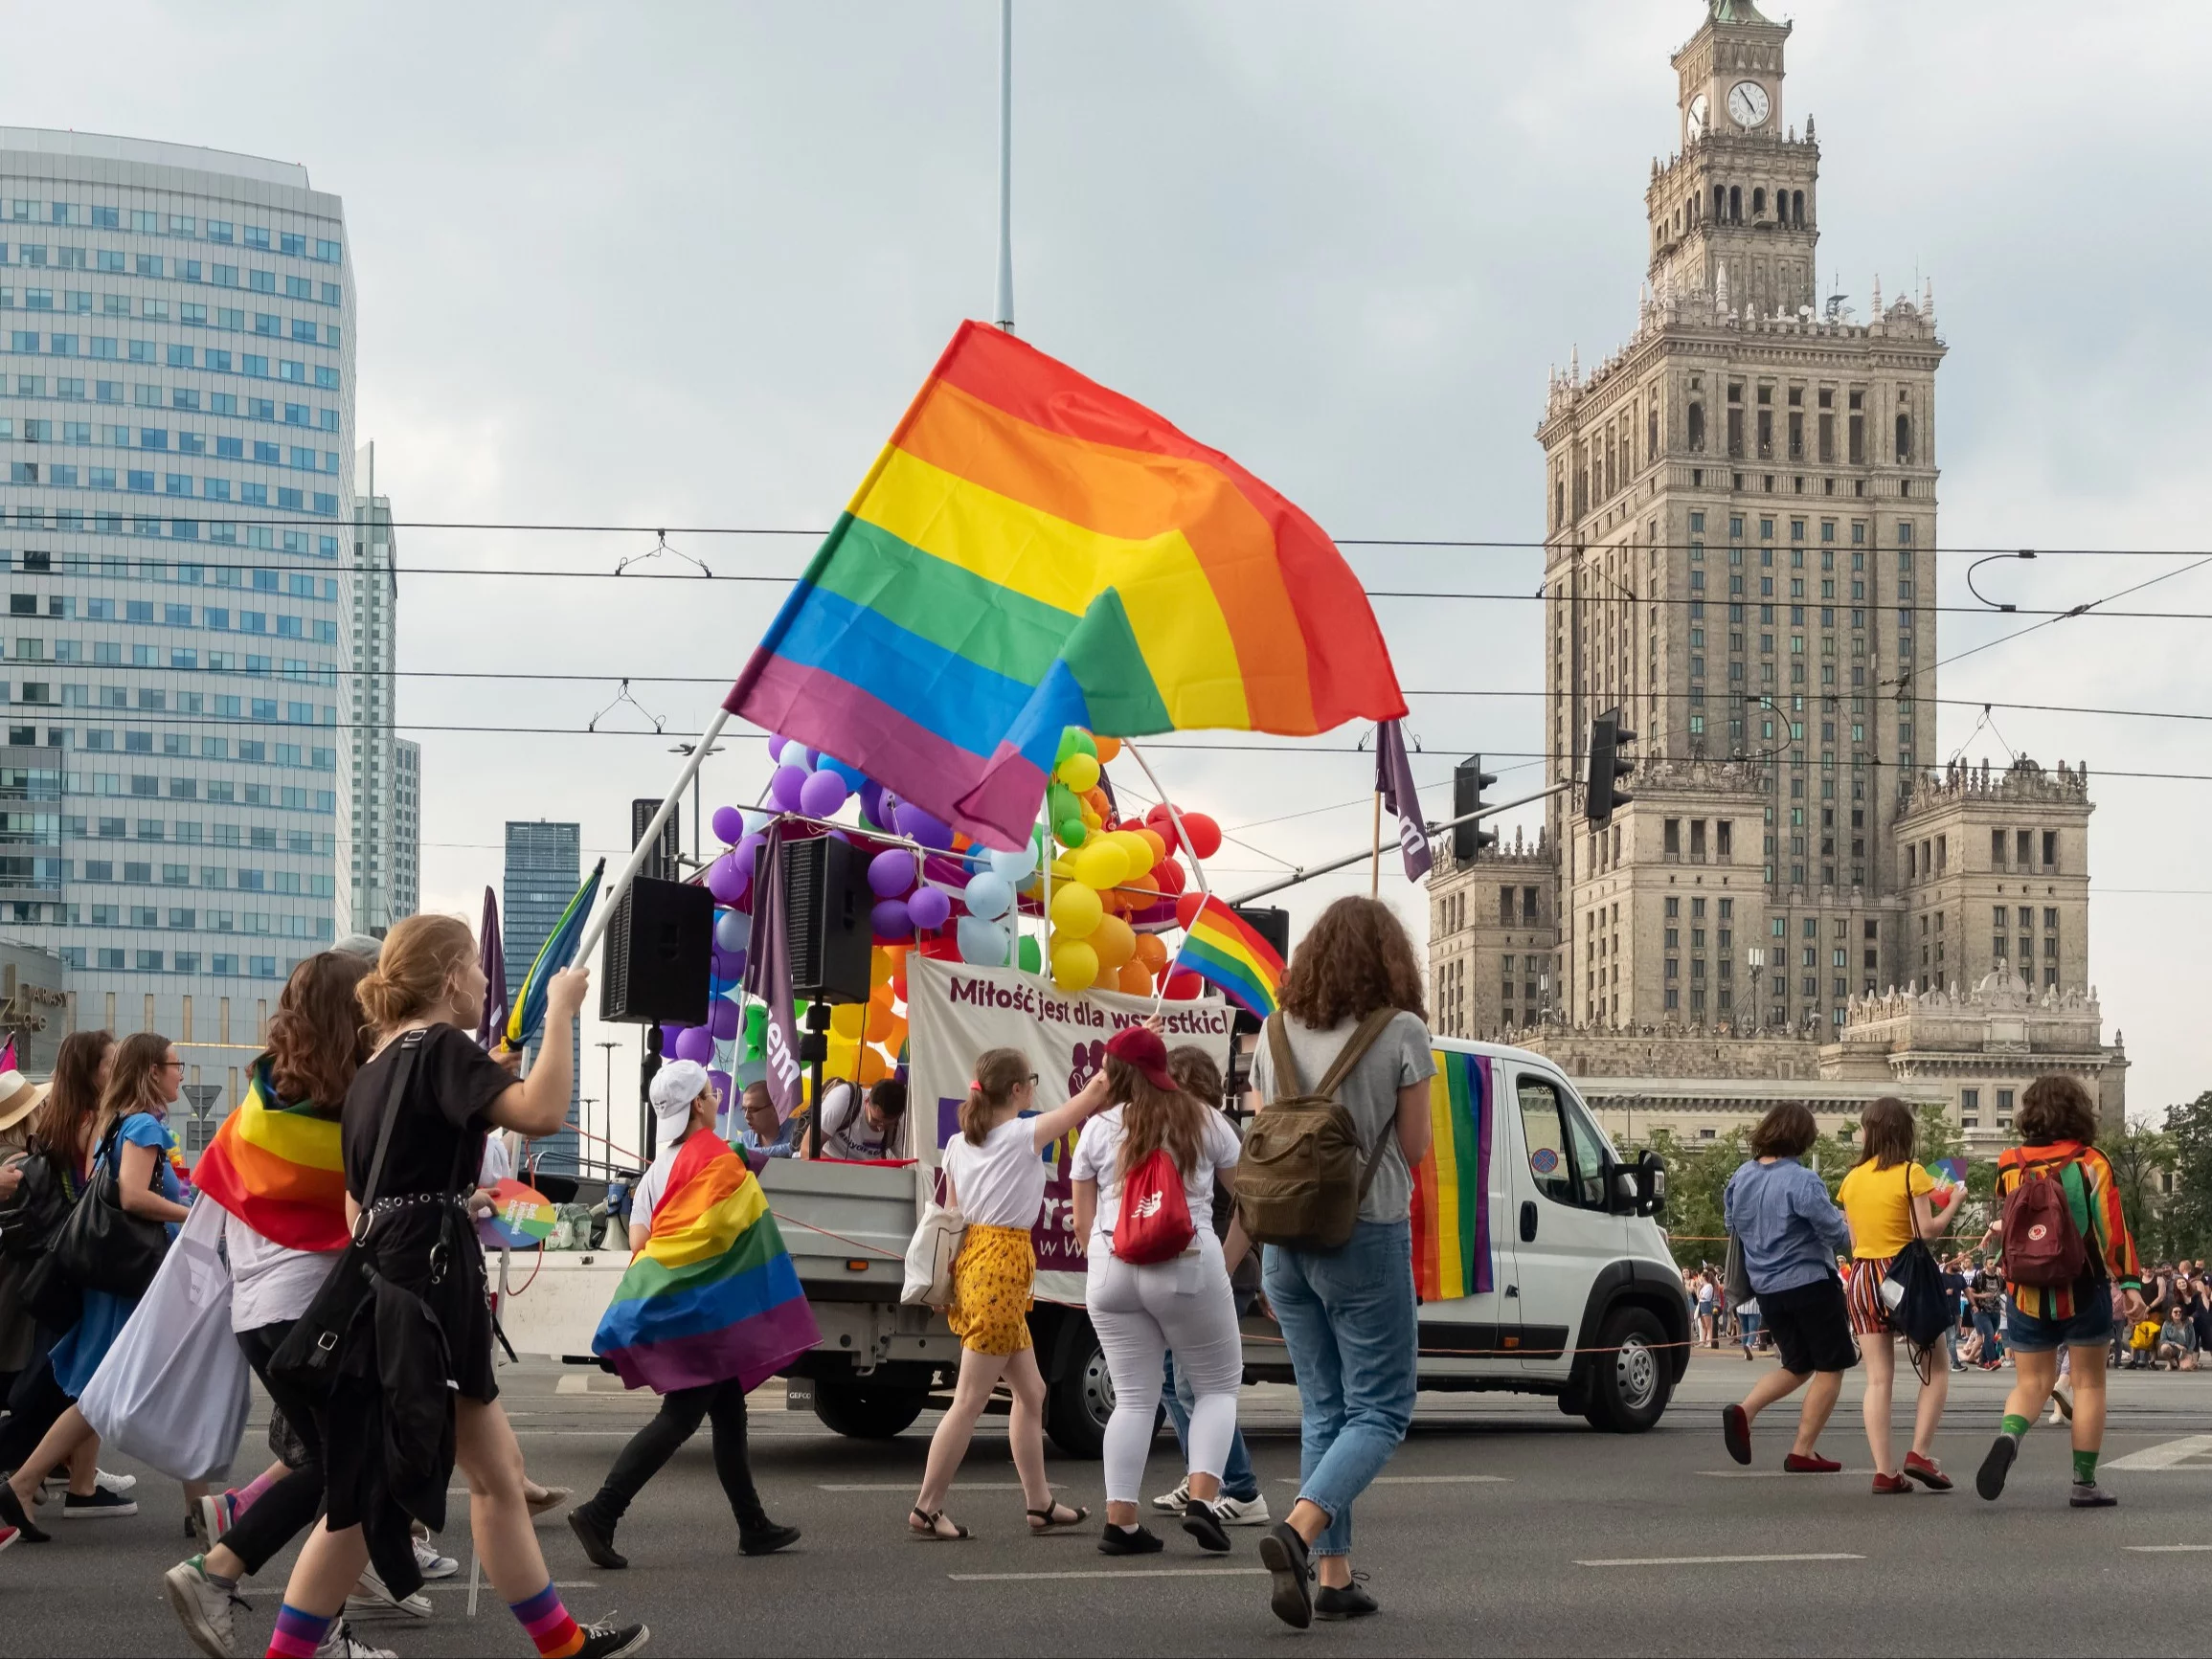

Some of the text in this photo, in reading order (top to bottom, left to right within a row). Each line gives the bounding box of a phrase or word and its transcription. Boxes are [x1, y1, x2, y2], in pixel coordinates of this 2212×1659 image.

[950, 976, 1229, 1035] Miłość jest dla wsstkic
[789, 1391, 812, 1400] GEFCO
